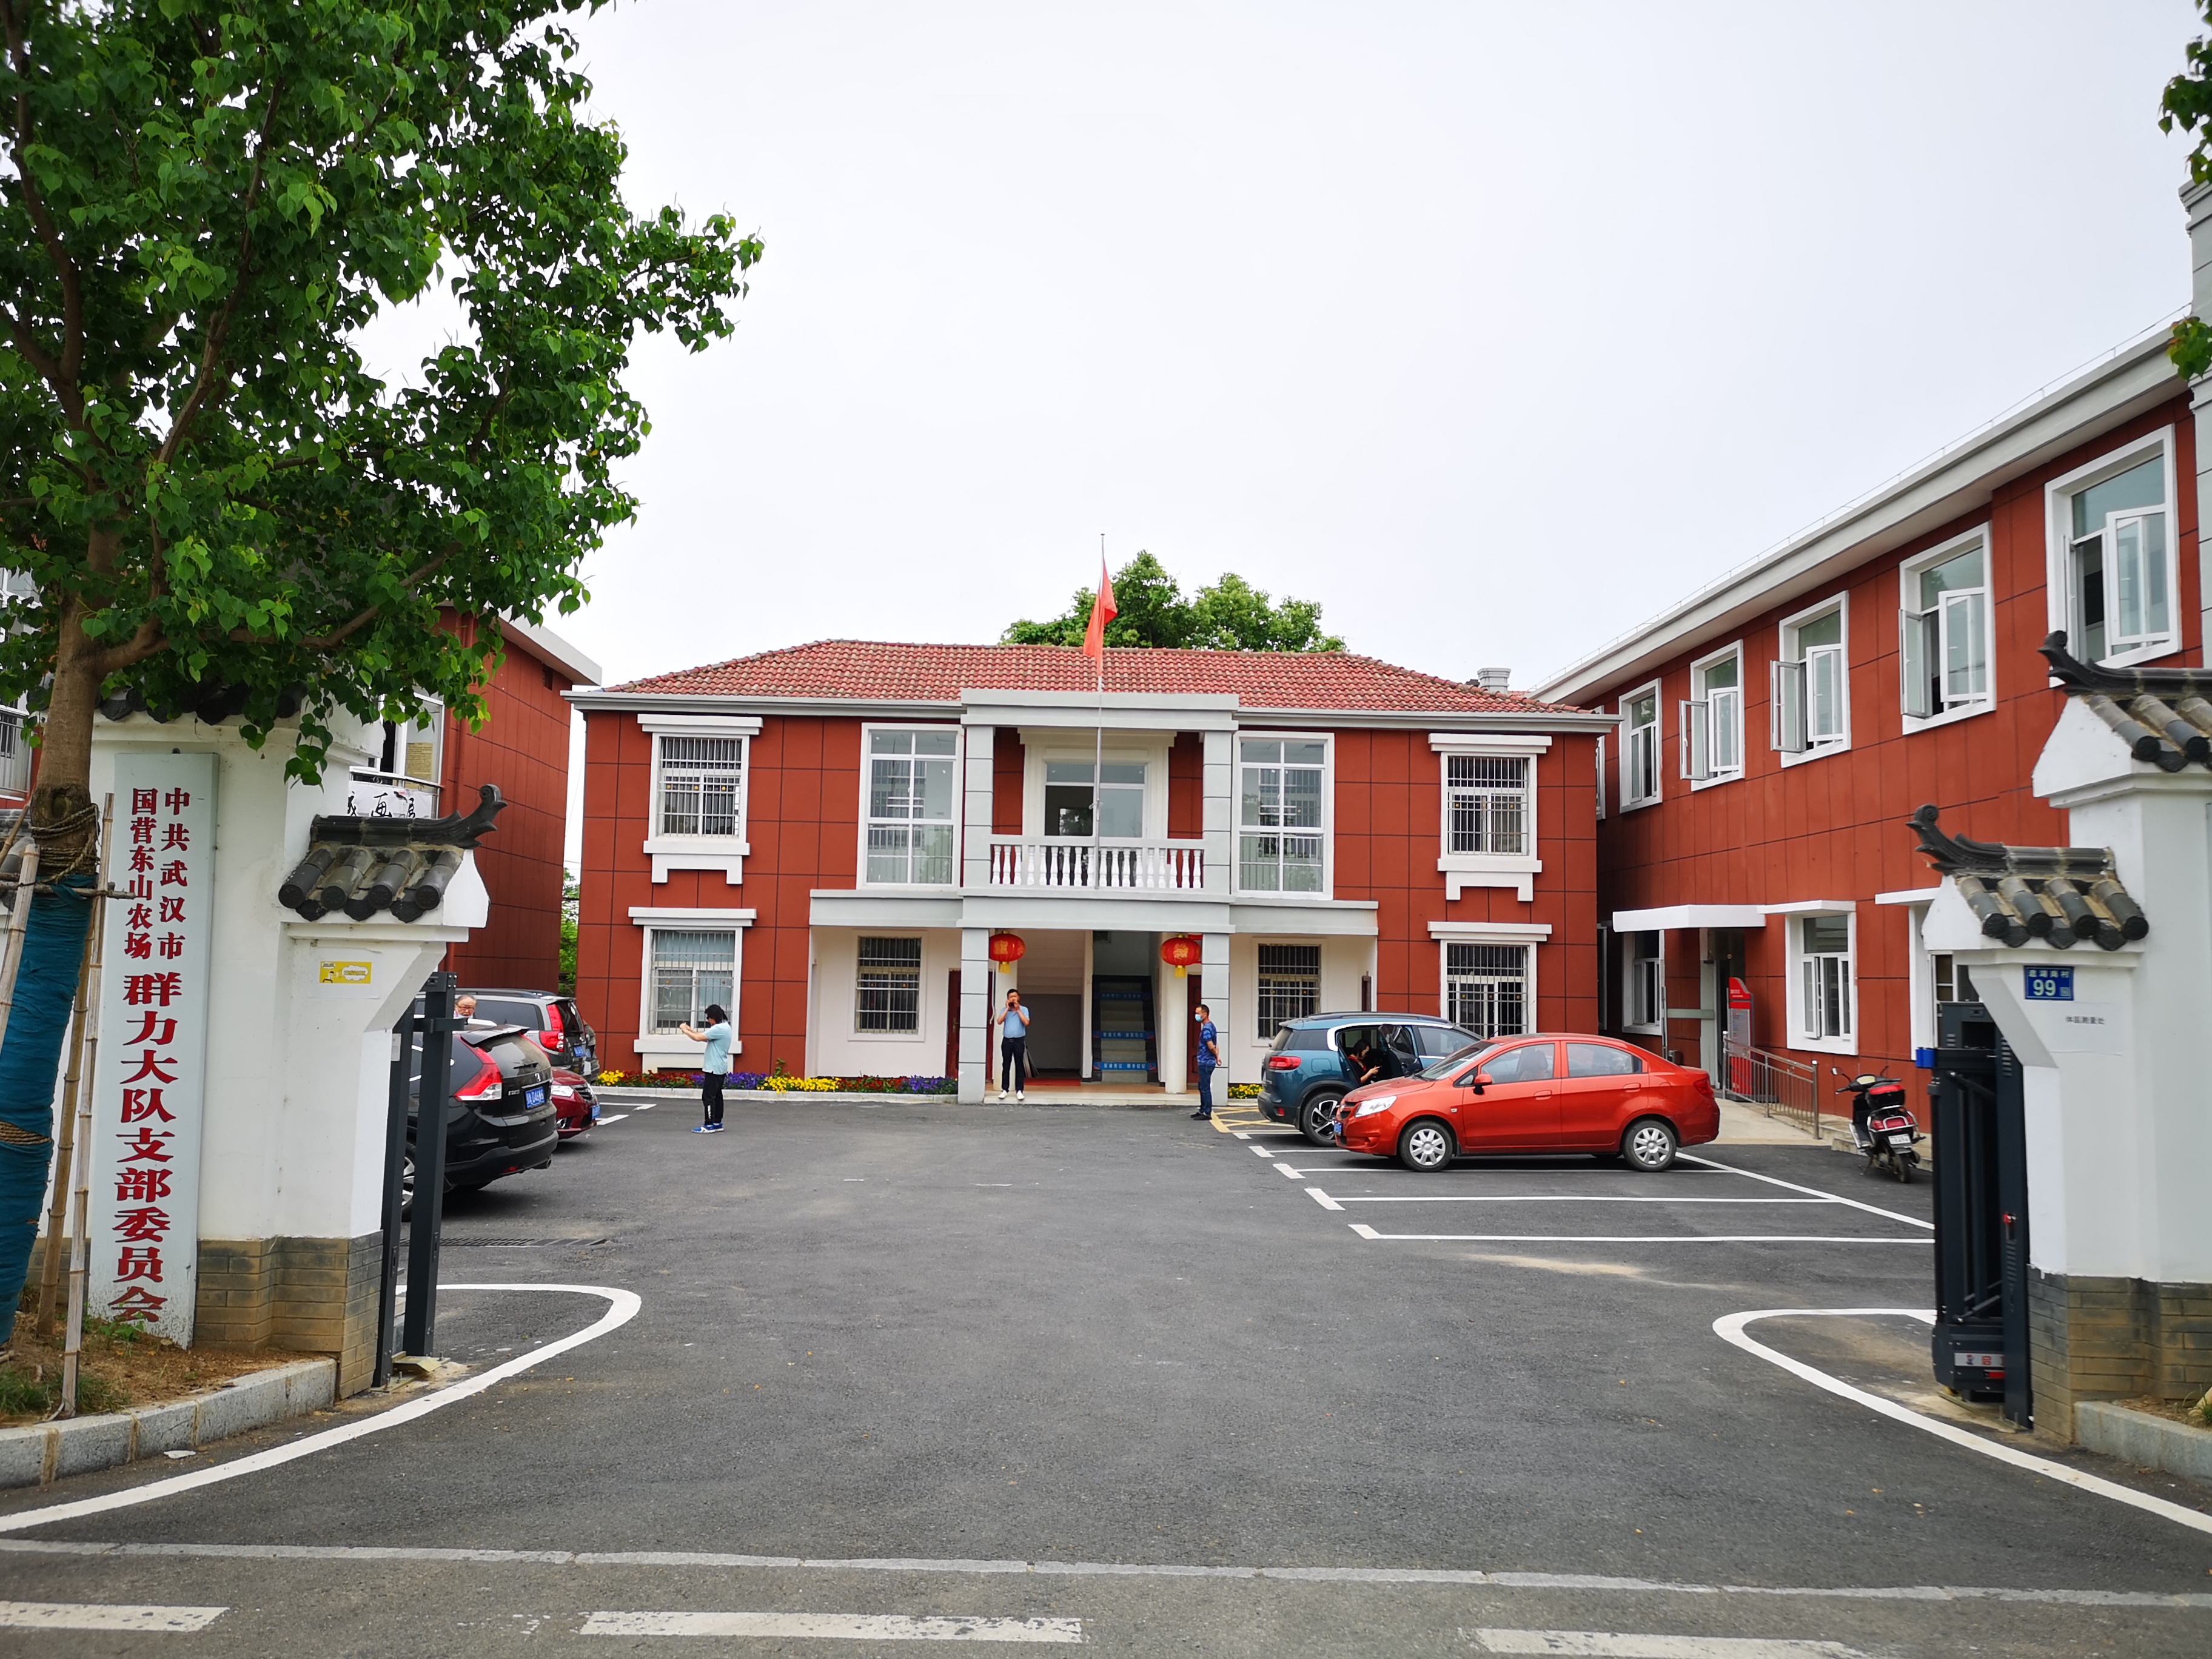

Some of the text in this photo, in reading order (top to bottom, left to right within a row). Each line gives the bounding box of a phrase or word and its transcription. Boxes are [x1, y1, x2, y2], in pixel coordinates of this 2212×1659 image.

[124, 788, 158, 960] 国营东山农场
[157, 787, 190, 960] 中共武汉市
[2033, 979, 2056, 996] 99
[107, 971, 183, 1323] 群力大队支部委员会
